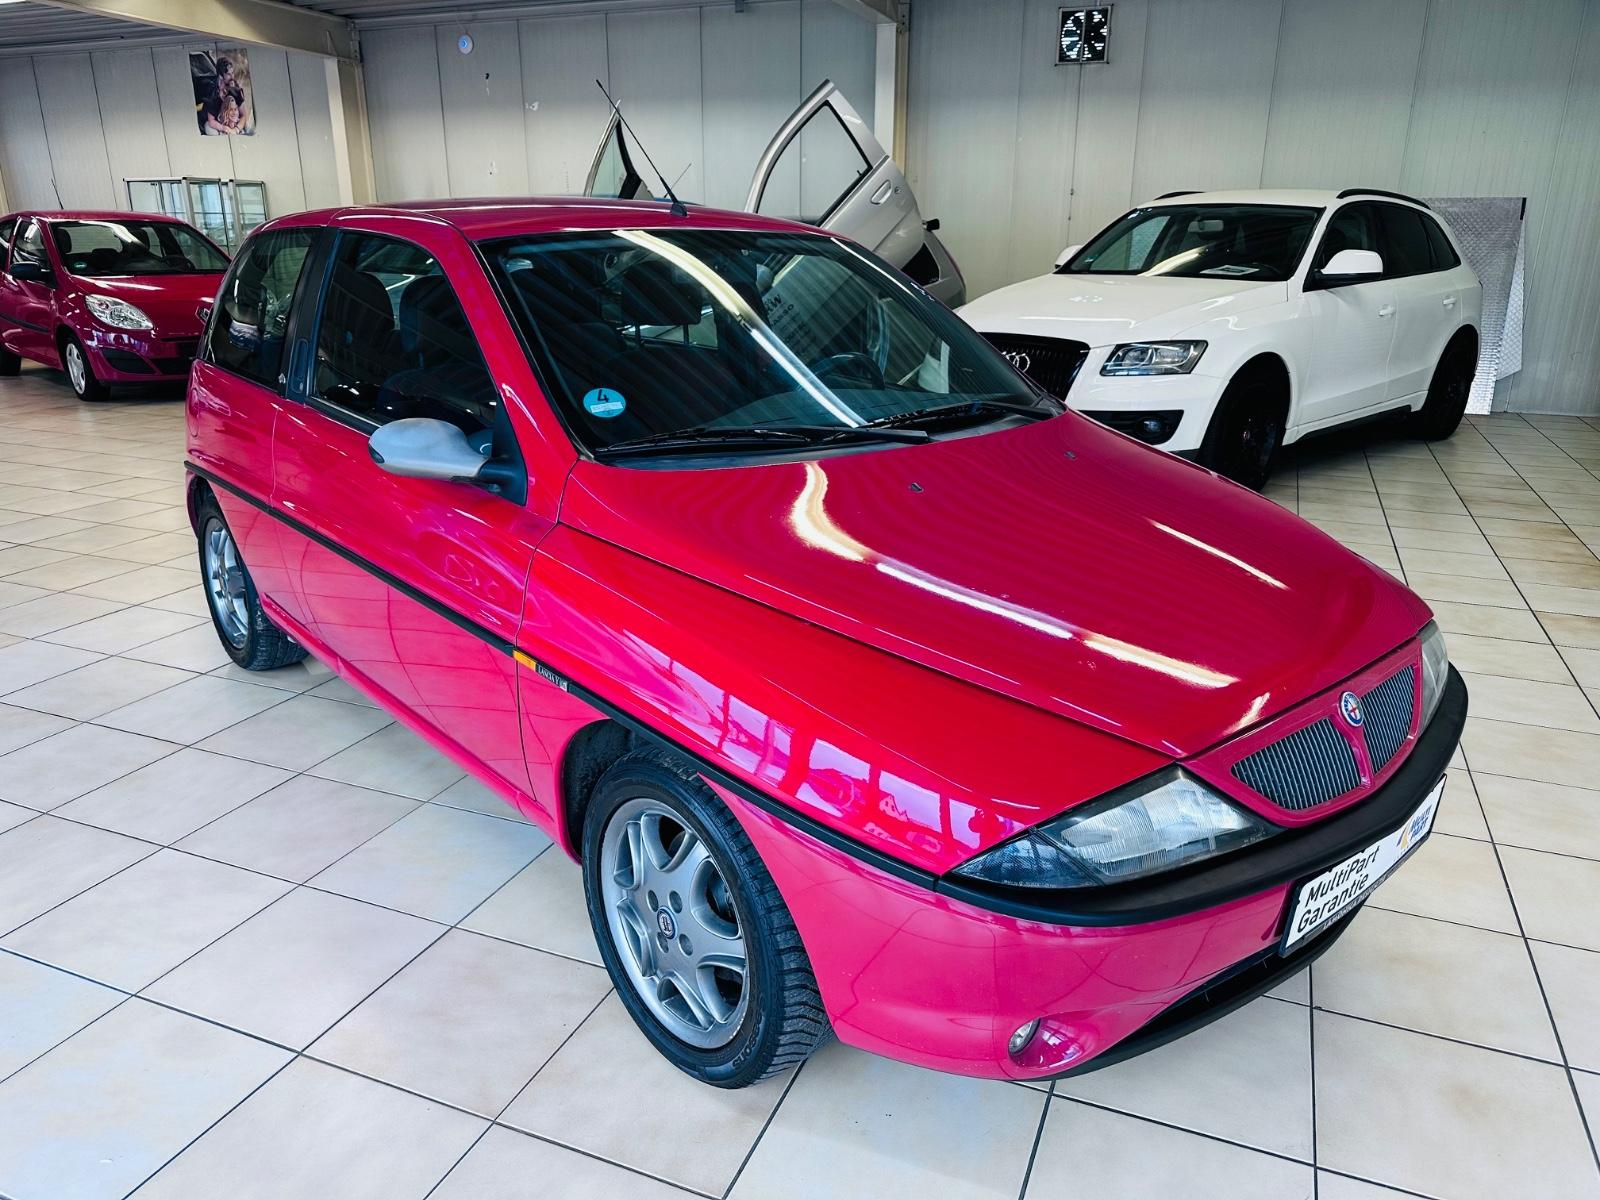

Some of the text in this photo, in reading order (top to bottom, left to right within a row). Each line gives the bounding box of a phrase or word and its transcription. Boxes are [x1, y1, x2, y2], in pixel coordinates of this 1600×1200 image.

[597, 389, 609, 403] 4
[1297, 873, 1369, 933] Garantie
[1304, 845, 1380, 908] MultiPart
